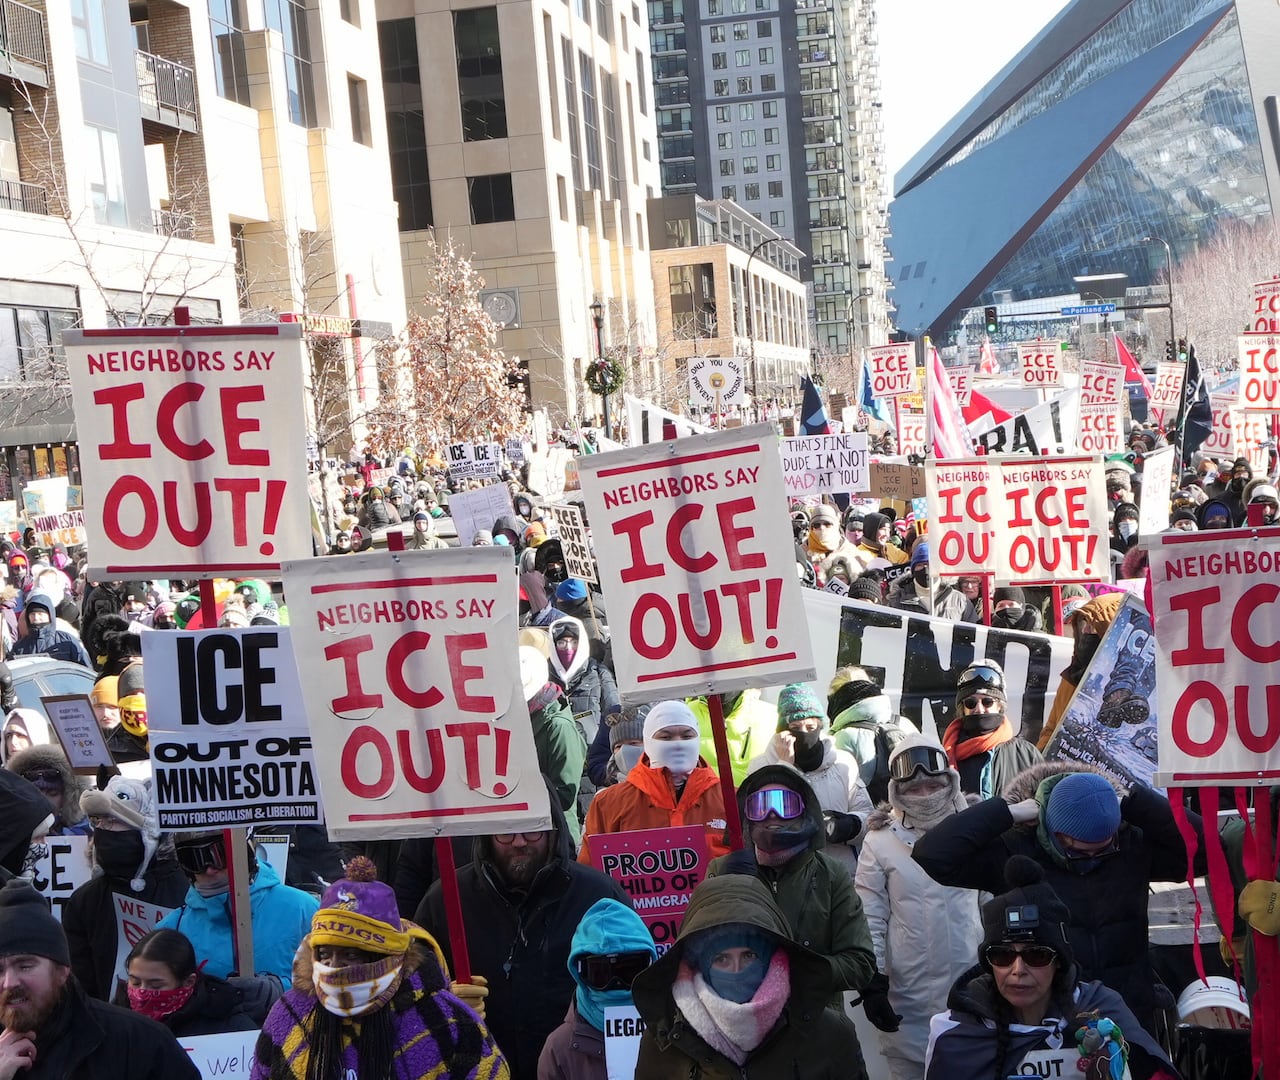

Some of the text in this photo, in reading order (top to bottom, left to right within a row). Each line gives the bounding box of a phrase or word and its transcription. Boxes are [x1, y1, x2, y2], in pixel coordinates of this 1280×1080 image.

[1070, 304, 1114, 314] Portland Av
[87, 349, 275, 375] NEIGHBORS SAY
[873, 355, 908, 373] ICE
[1023, 354, 1055, 369] ICE
[692, 376, 743, 401] PREVENT FASCISM
[874, 374, 911, 391] OUT!
[1024, 369, 1058, 383] OUT!
[93, 382, 271, 467] ICE
[823, 435, 851, 450] FINE
[784, 456, 810, 472] DUDE
[840, 450, 867, 467] NOT
[784, 470, 859, 490] MAD AT YOU
[1003, 469, 1092, 483] NEIGHBORS SAY
[603, 467, 759, 513] NEIGHBORS SAY
[103, 475, 287, 556] OUT!
[555, 510, 578, 527] ICE
[1006, 485, 1090, 529] ICE
[559, 524, 582, 540] OUT
[612, 496, 767, 583] ICE
[1009, 534, 1099, 576] OUT!
[566, 559, 591, 577] MPLS
[318, 599, 494, 630] NEIGHBORS SAY
[630, 578, 784, 660] OUT!
[176, 633, 282, 725] ICE
[325, 631, 496, 713] ICE
[154, 737, 312, 763] OUT OF
[341, 722, 511, 798] OUT!
[156, 762, 316, 803] MINNESOTA
[161, 805, 314, 825] PARTY FOR SOCIALISM & LIBERATION
[602, 848, 700, 877] PROUD
[620, 873, 699, 895] HILD OF
[119, 899, 147, 920] WE
